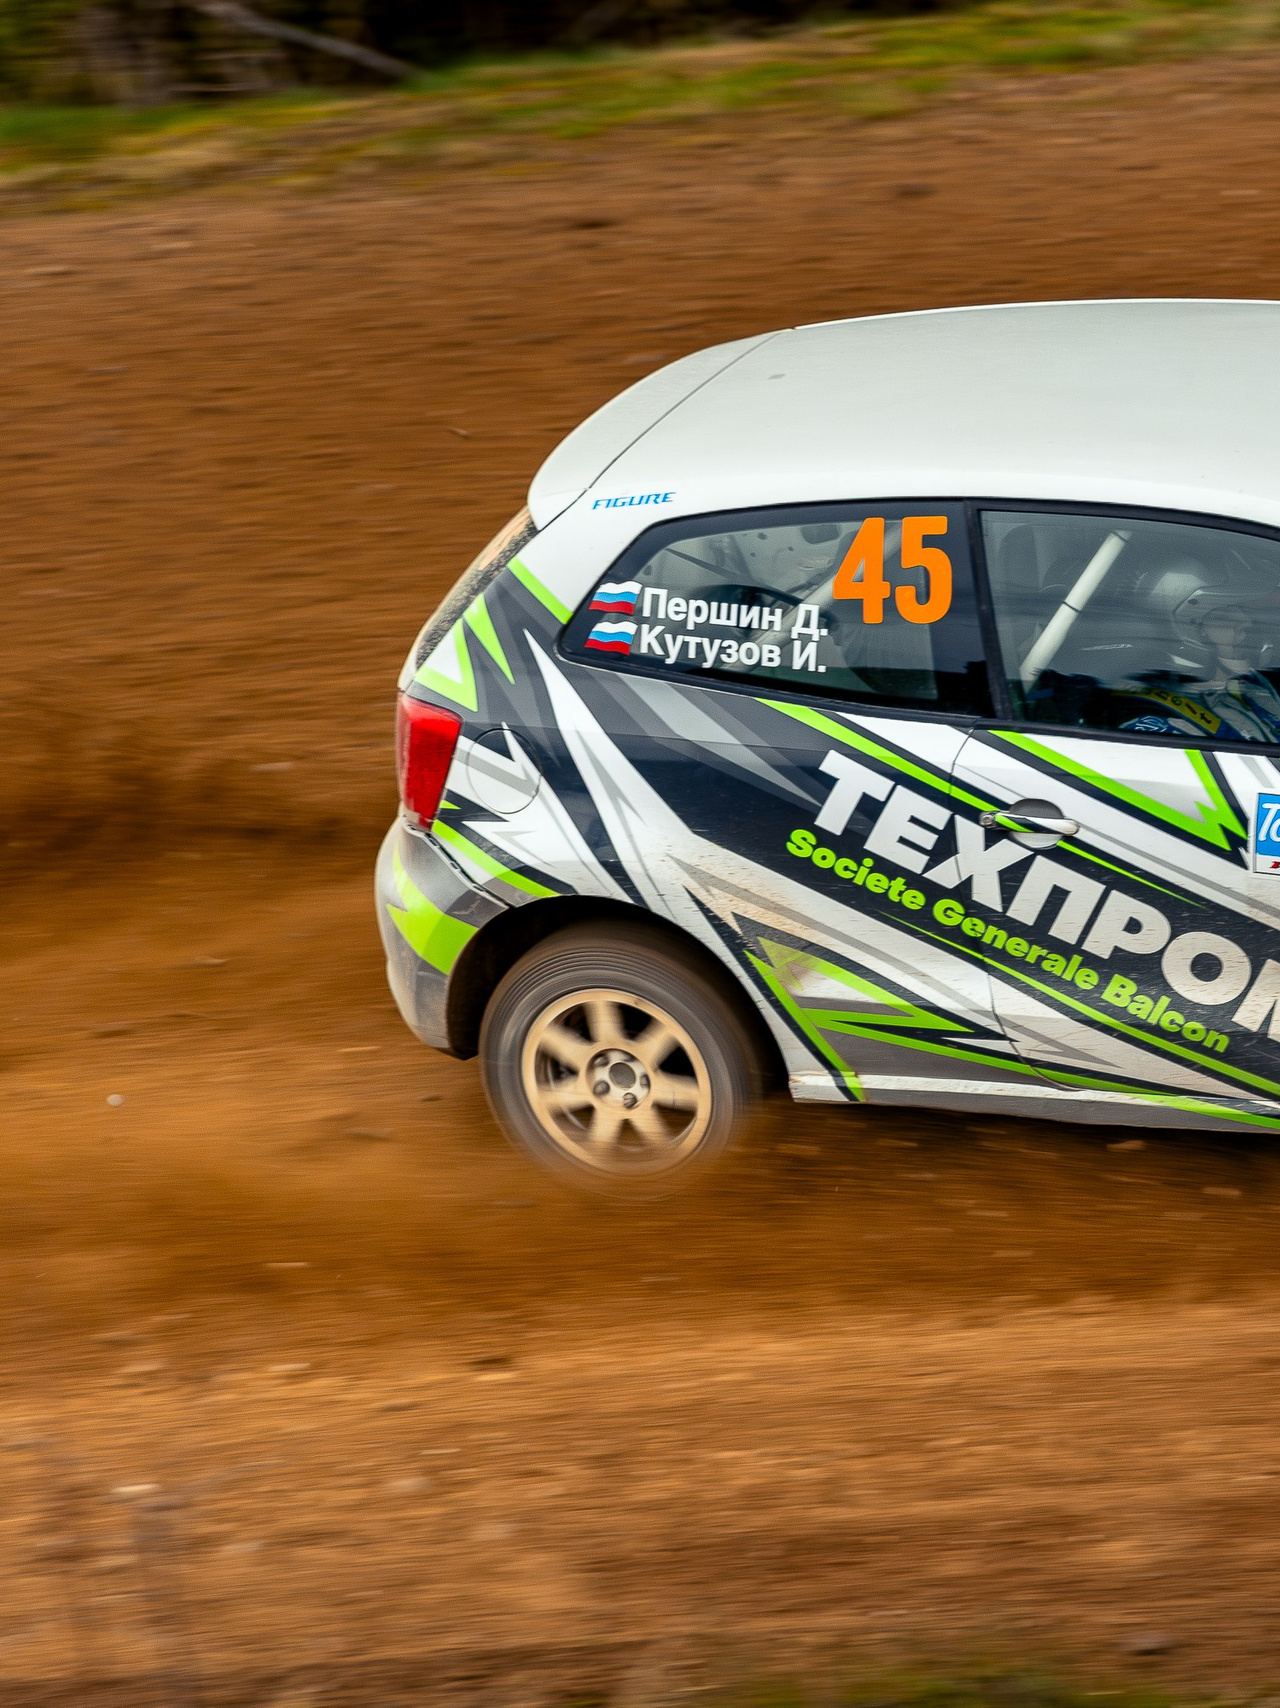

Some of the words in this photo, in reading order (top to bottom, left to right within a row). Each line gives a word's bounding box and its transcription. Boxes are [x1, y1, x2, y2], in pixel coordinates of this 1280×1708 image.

[592, 492, 677, 510] FIGURE
[833, 515, 953, 624] 45
[641, 587, 783, 631] Першин
[791, 604, 829, 640] Д.
[638, 624, 782, 669] Кутузов
[791, 640, 828, 673] И.
[785, 828, 925, 911] Societe
[932, 897, 1099, 991] Generale
[1100, 973, 1231, 1054] Balcon
